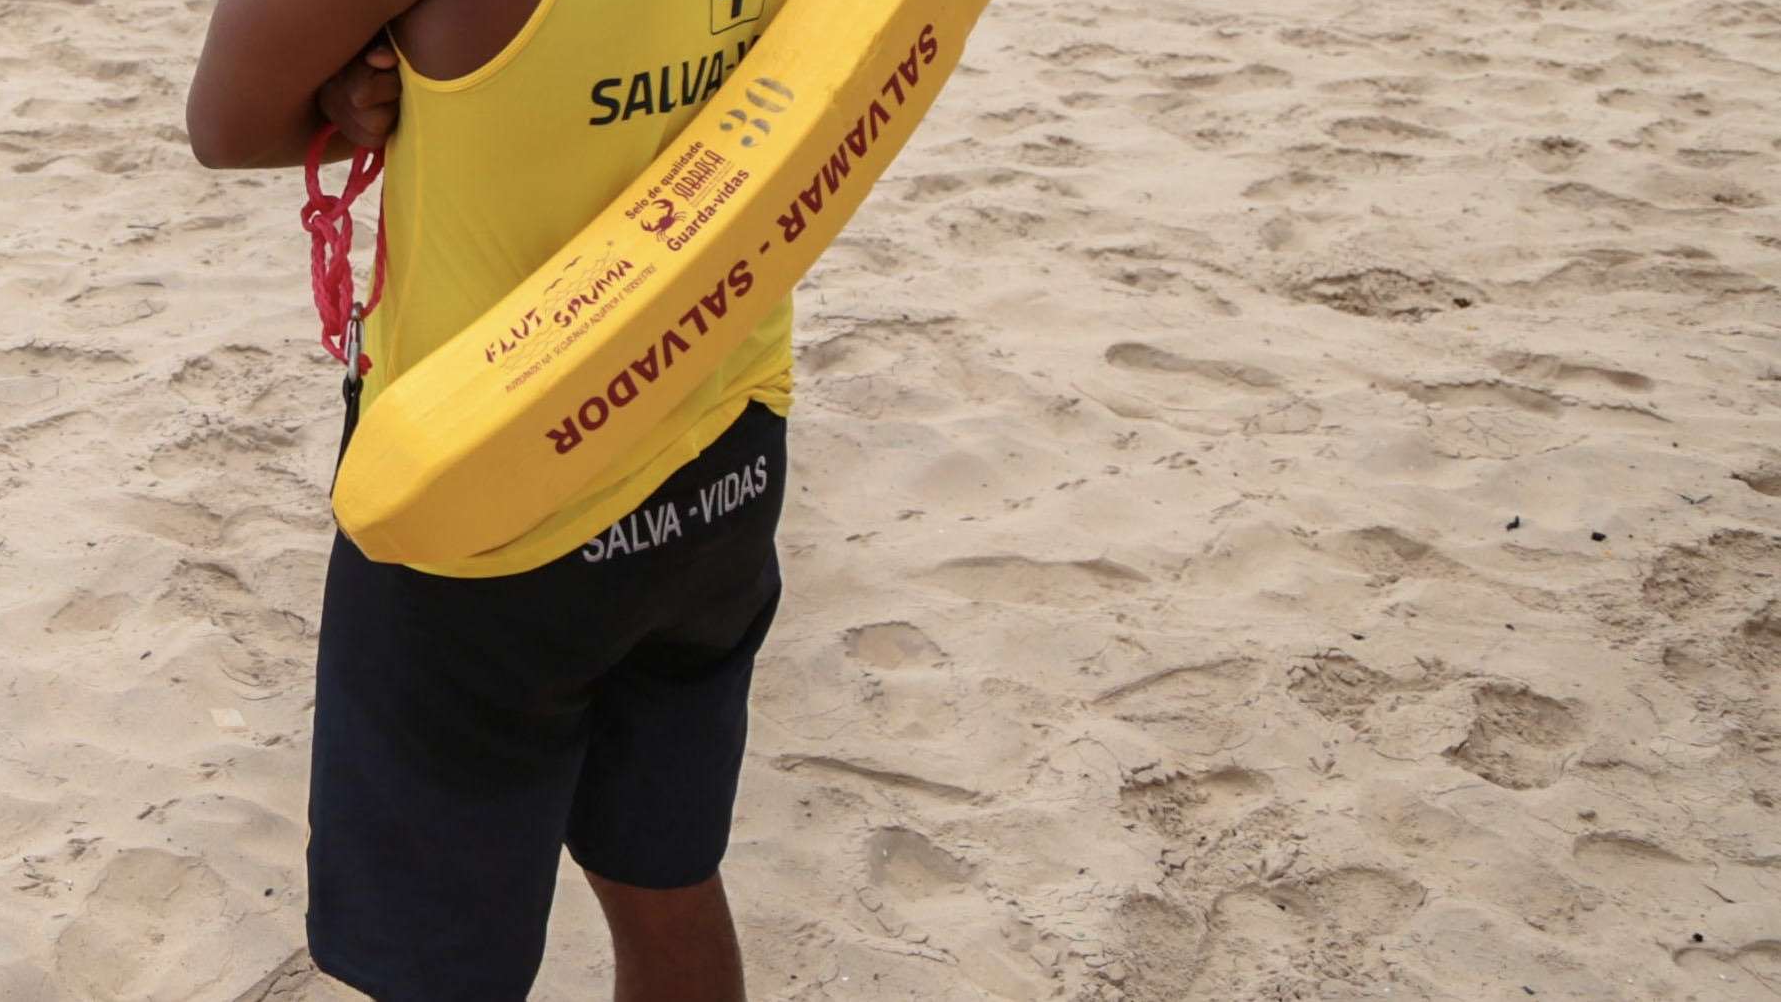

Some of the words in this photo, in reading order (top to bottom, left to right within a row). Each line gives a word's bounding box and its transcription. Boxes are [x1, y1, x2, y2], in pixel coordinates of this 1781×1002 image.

[719, 77, 795, 148] 30
[777, 24, 939, 244] SALVAMAR
[625, 199, 650, 220] Selo
[648, 186, 662, 200] de
[660, 140, 704, 186] qualidade
[666, 168, 750, 252] Guarda-vidas
[672, 149, 727, 201] SOBRASA
[554, 259, 635, 328] SPUMA
[546, 259, 755, 455] SALVADOR
[582, 502, 682, 563] SALVA
